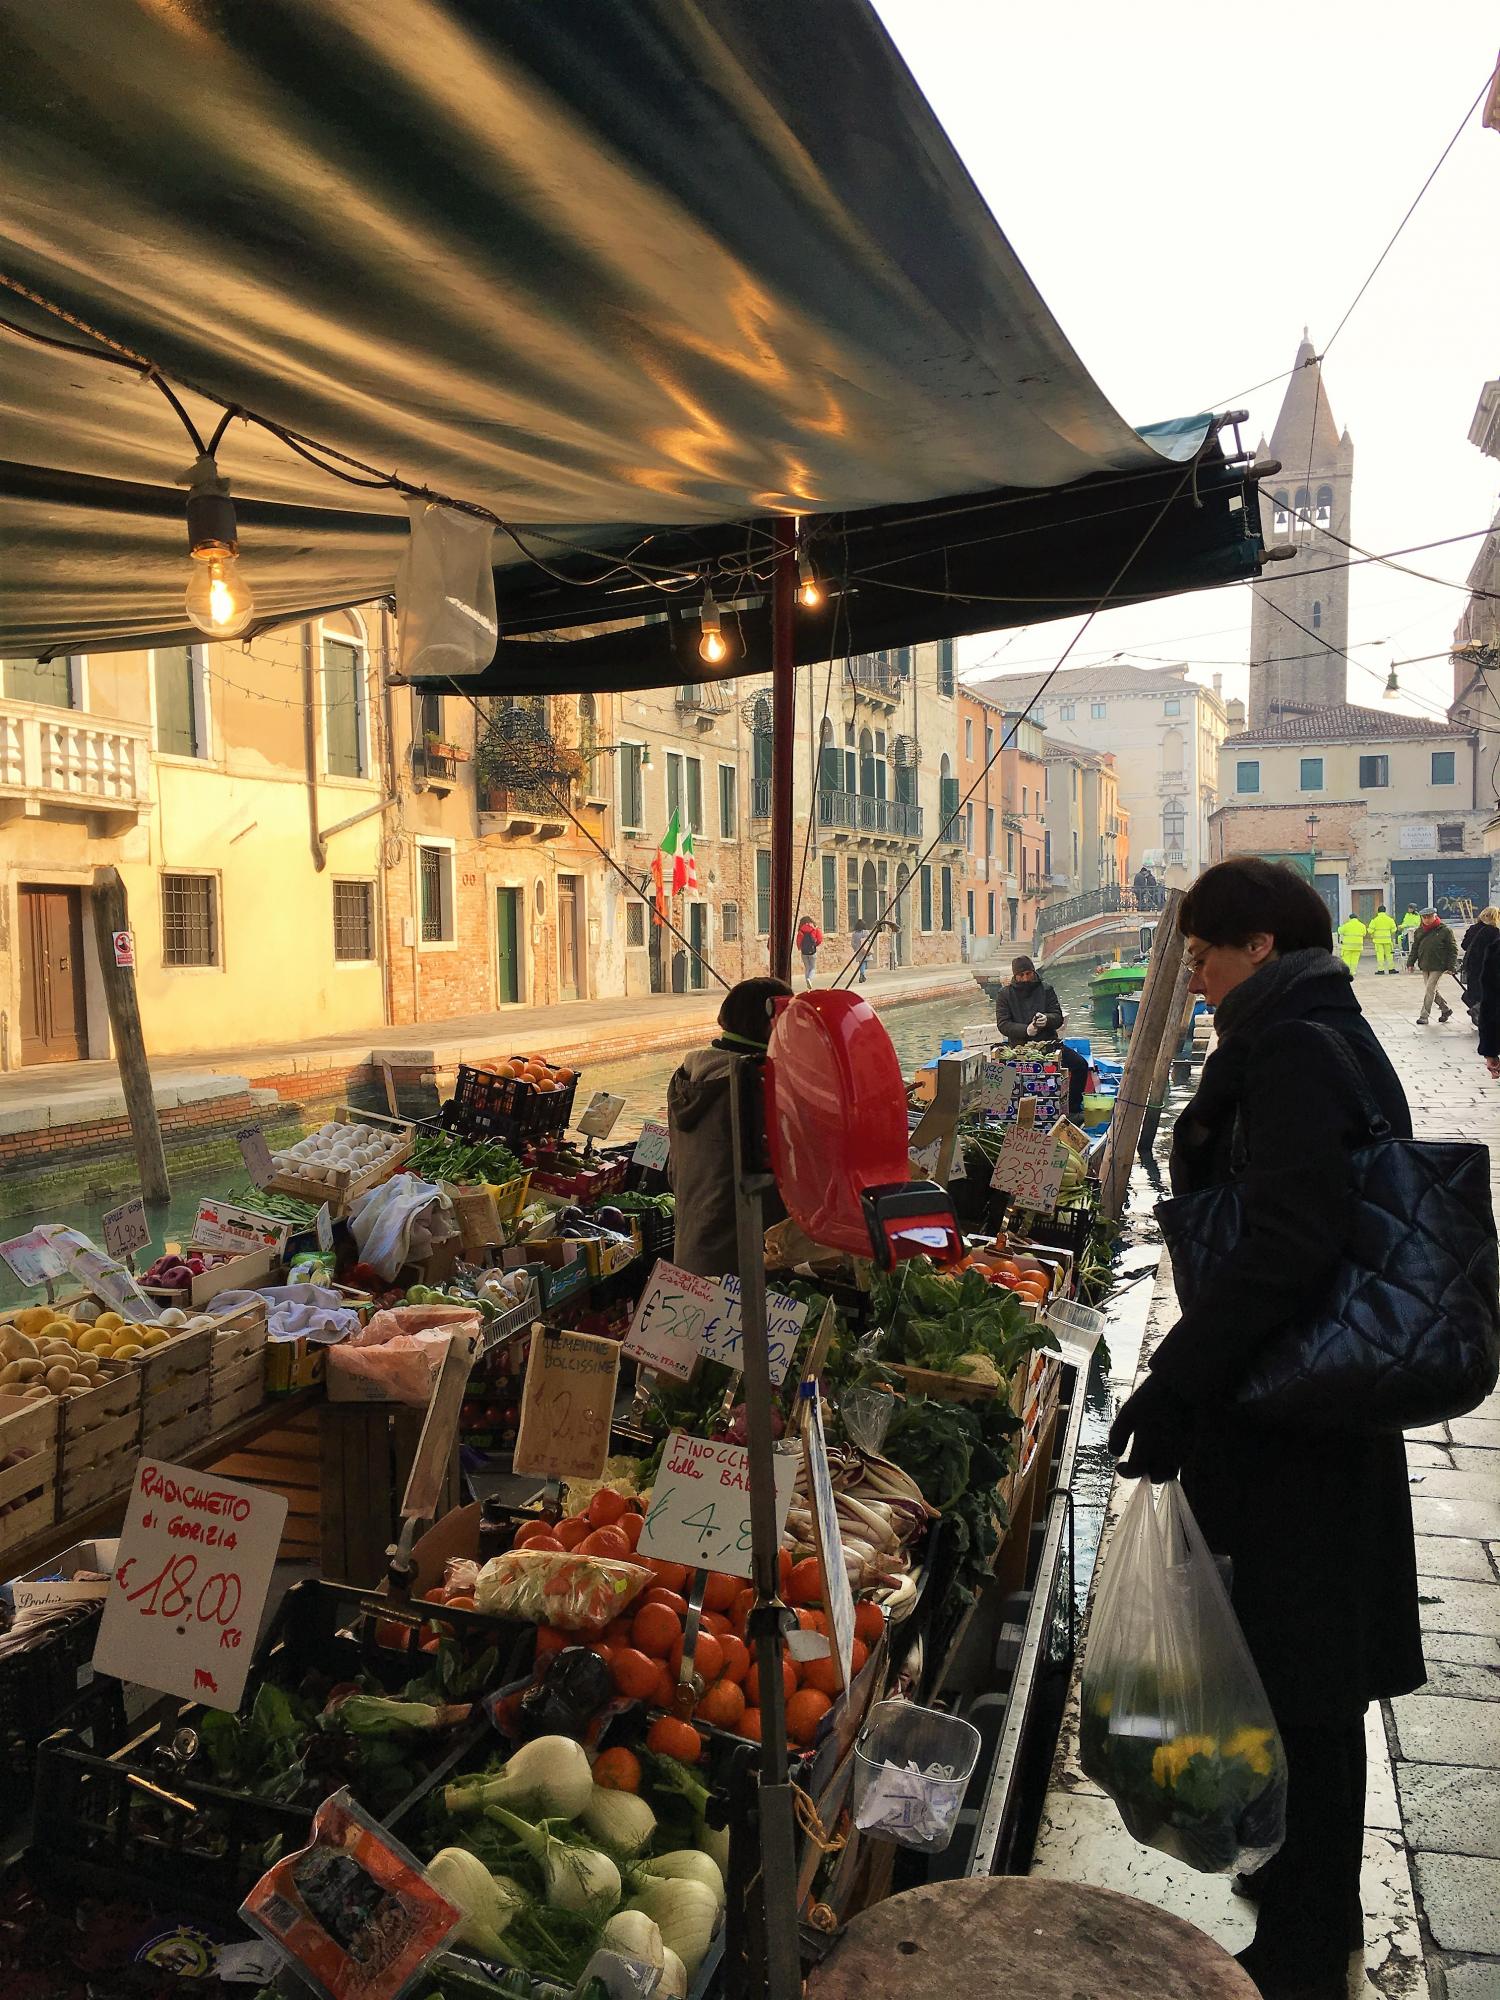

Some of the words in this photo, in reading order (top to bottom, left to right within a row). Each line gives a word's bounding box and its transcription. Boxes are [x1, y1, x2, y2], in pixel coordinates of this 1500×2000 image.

[1007, 1127, 1052, 1146] ARANCE
[220, 1224, 259, 1241] SAMIRA
[667, 1456, 704, 1480] della
[219, 1628, 242, 1649] KG
